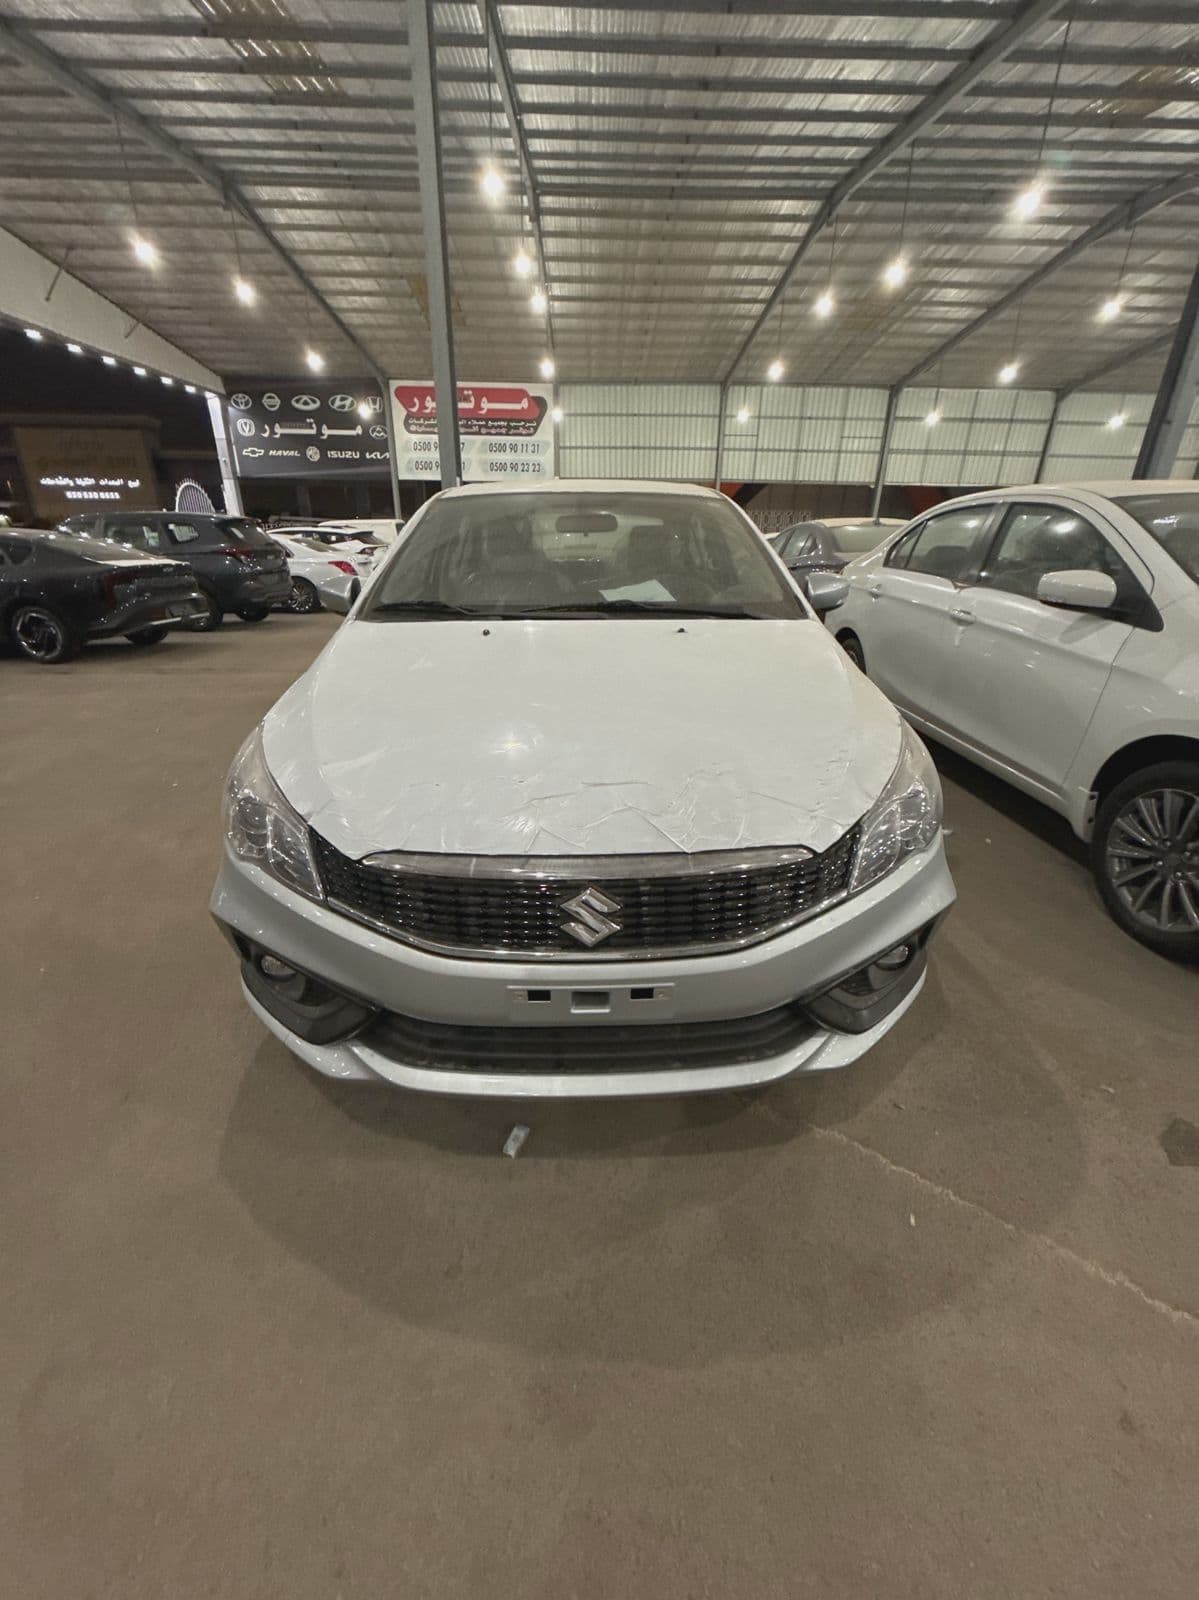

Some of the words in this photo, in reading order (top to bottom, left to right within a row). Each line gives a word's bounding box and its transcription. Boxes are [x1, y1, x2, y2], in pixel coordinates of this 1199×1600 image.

[261, 418, 363, 439] موتور
[413, 441, 432, 451] 0500
[489, 442, 507, 453] 0500
[509, 443, 518, 453] 90
[521, 443, 529, 453] 11
[531, 443, 540, 453] 31
[268, 449, 301, 457] HAVAL
[327, 450, 360, 459] ISUZU
[415, 460, 433, 471] 0500
[490, 462, 507, 472] 0500
[510, 462, 518, 472] 90
[521, 462, 529, 472] 23
[532, 463, 541, 473] 23
